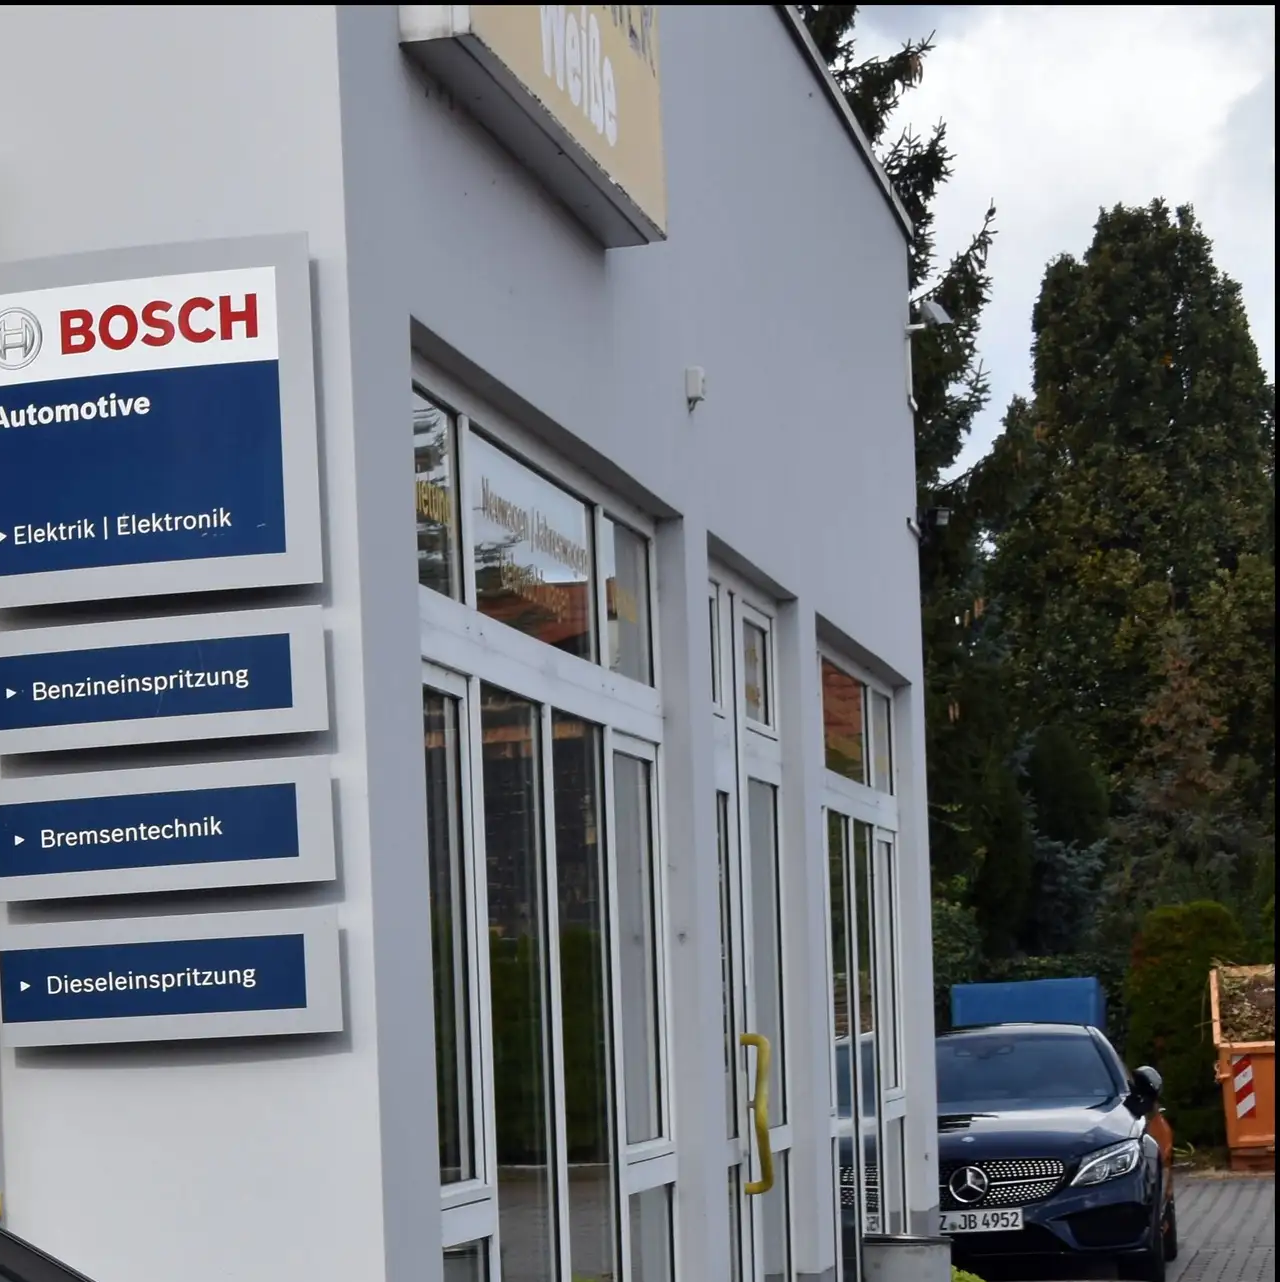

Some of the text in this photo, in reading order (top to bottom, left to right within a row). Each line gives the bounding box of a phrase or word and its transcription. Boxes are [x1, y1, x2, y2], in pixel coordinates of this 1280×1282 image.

[60, 293, 258, 355] BOSCH
[13, 518, 95, 545] Elektrik
[116, 508, 232, 536] Elektronik
[32, 667, 249, 701] Benzineinspritzung
[40, 817, 223, 848] Bremsentechnik
[46, 966, 256, 994] Dieseleinspritzung
[958, 1213, 977, 1230] JB
[981, 1211, 1020, 1229] 4952
